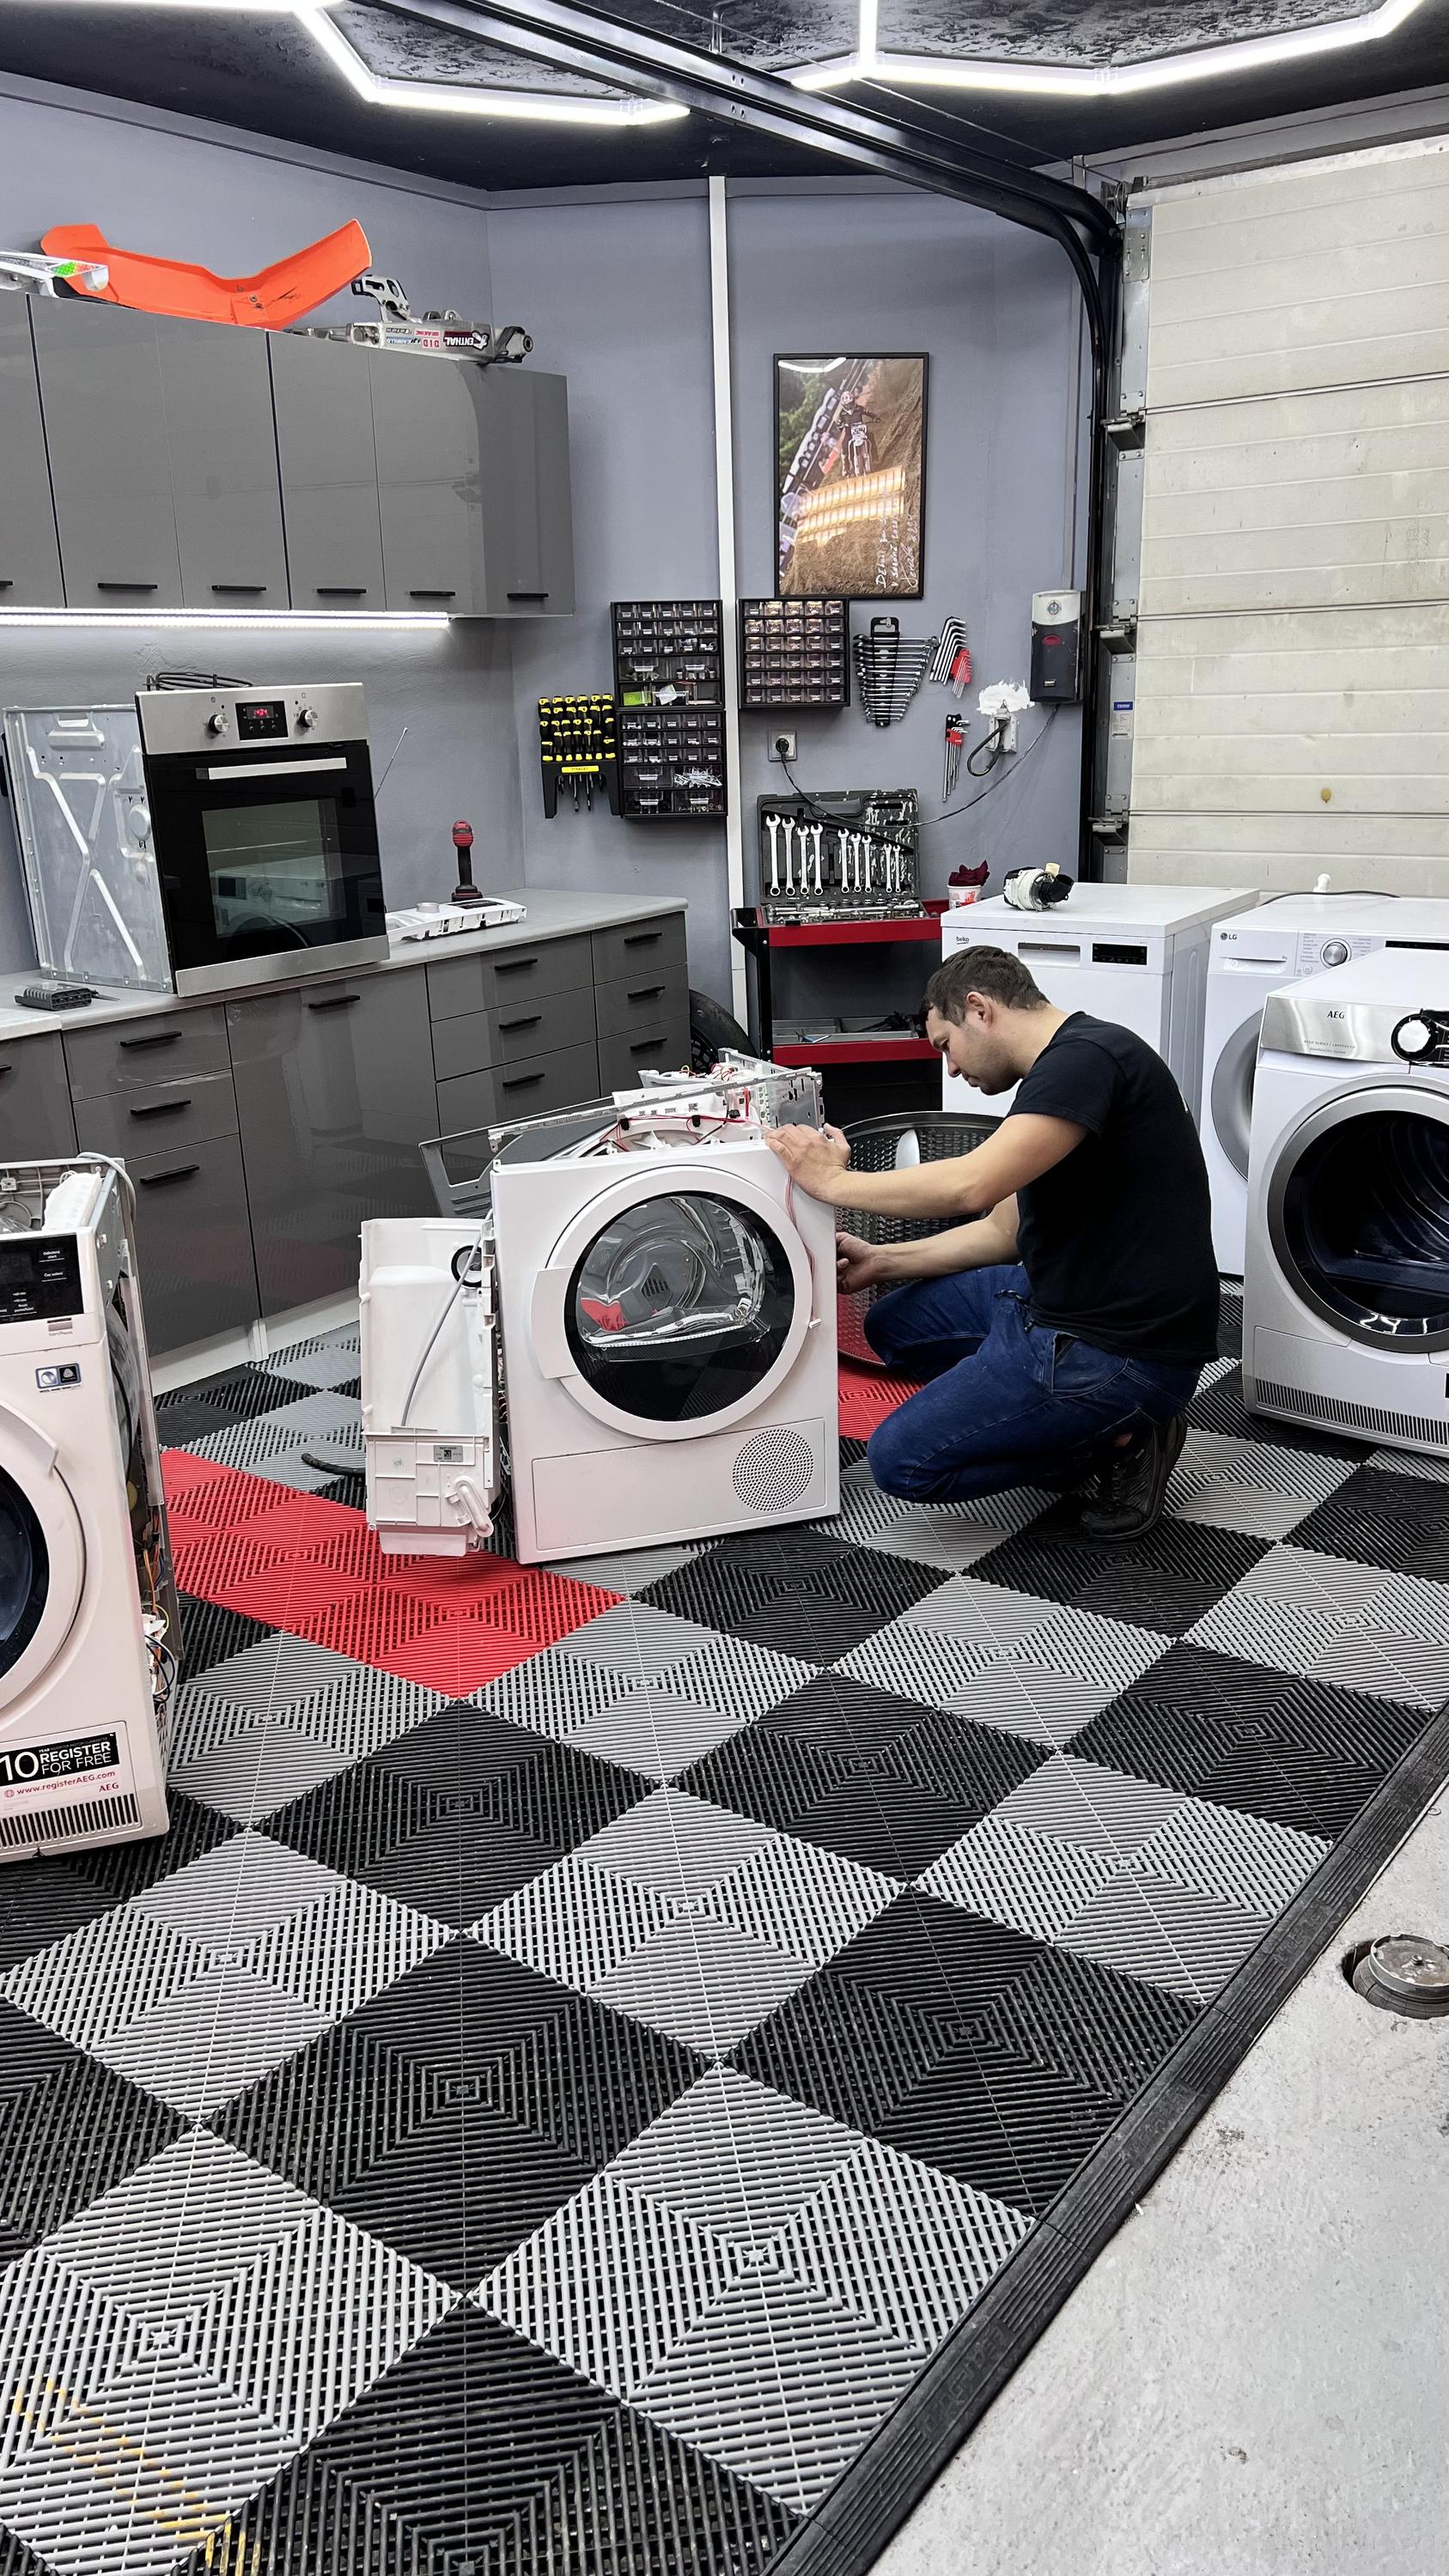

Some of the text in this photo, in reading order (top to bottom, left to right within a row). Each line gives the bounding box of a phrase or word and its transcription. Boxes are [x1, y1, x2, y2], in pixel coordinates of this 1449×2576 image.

[1327, 1010, 1346, 1019] AEG
[39, 1741, 111, 1764] REGISTER
[41, 1752, 112, 1775] FOR FREE
[16, 1771, 116, 1795] www.registerAEG.com
[99, 1783, 119, 1792] AEG
